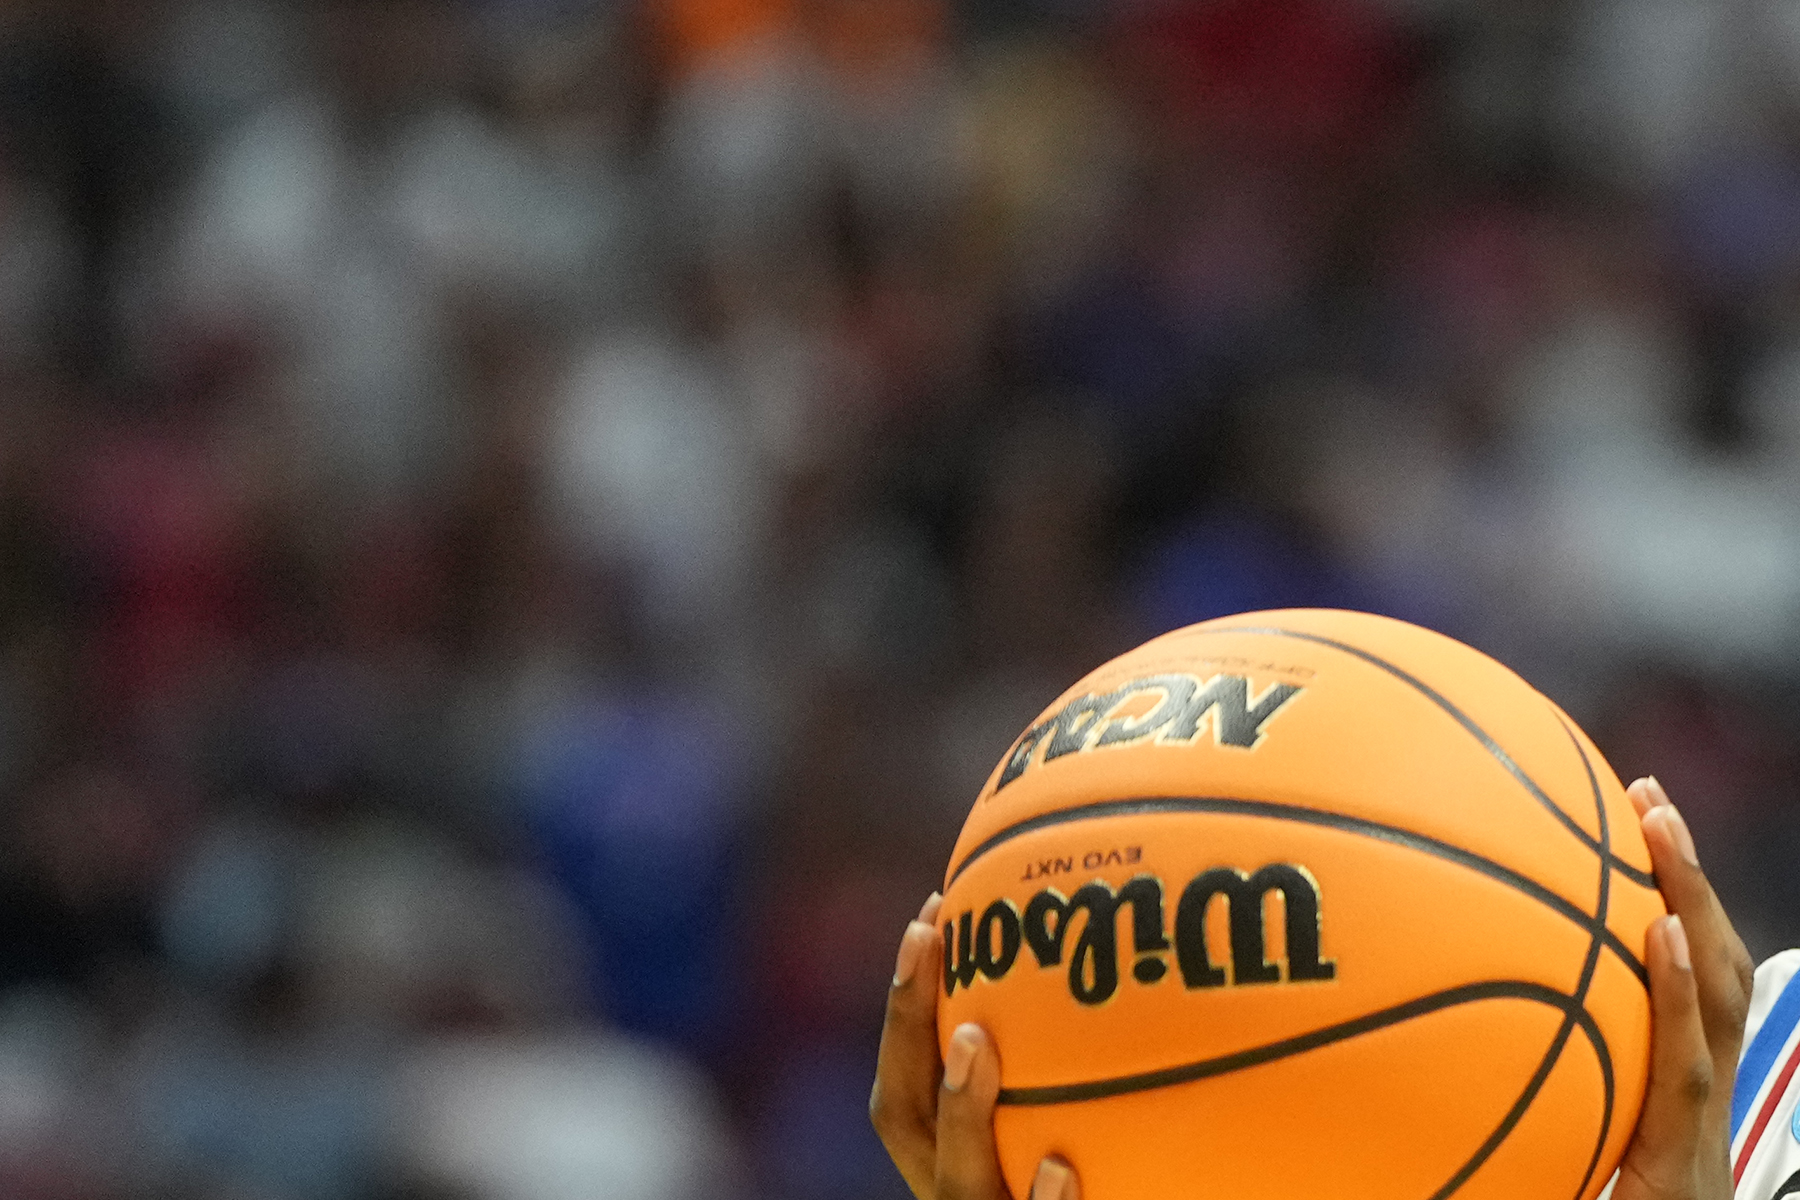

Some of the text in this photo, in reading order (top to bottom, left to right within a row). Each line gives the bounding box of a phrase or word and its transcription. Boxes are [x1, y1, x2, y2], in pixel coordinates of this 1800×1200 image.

[988, 673, 1307, 798] NCAA
[1020, 845, 1142, 881] EVO NXT
[943, 862, 1336, 1006] Wilson
